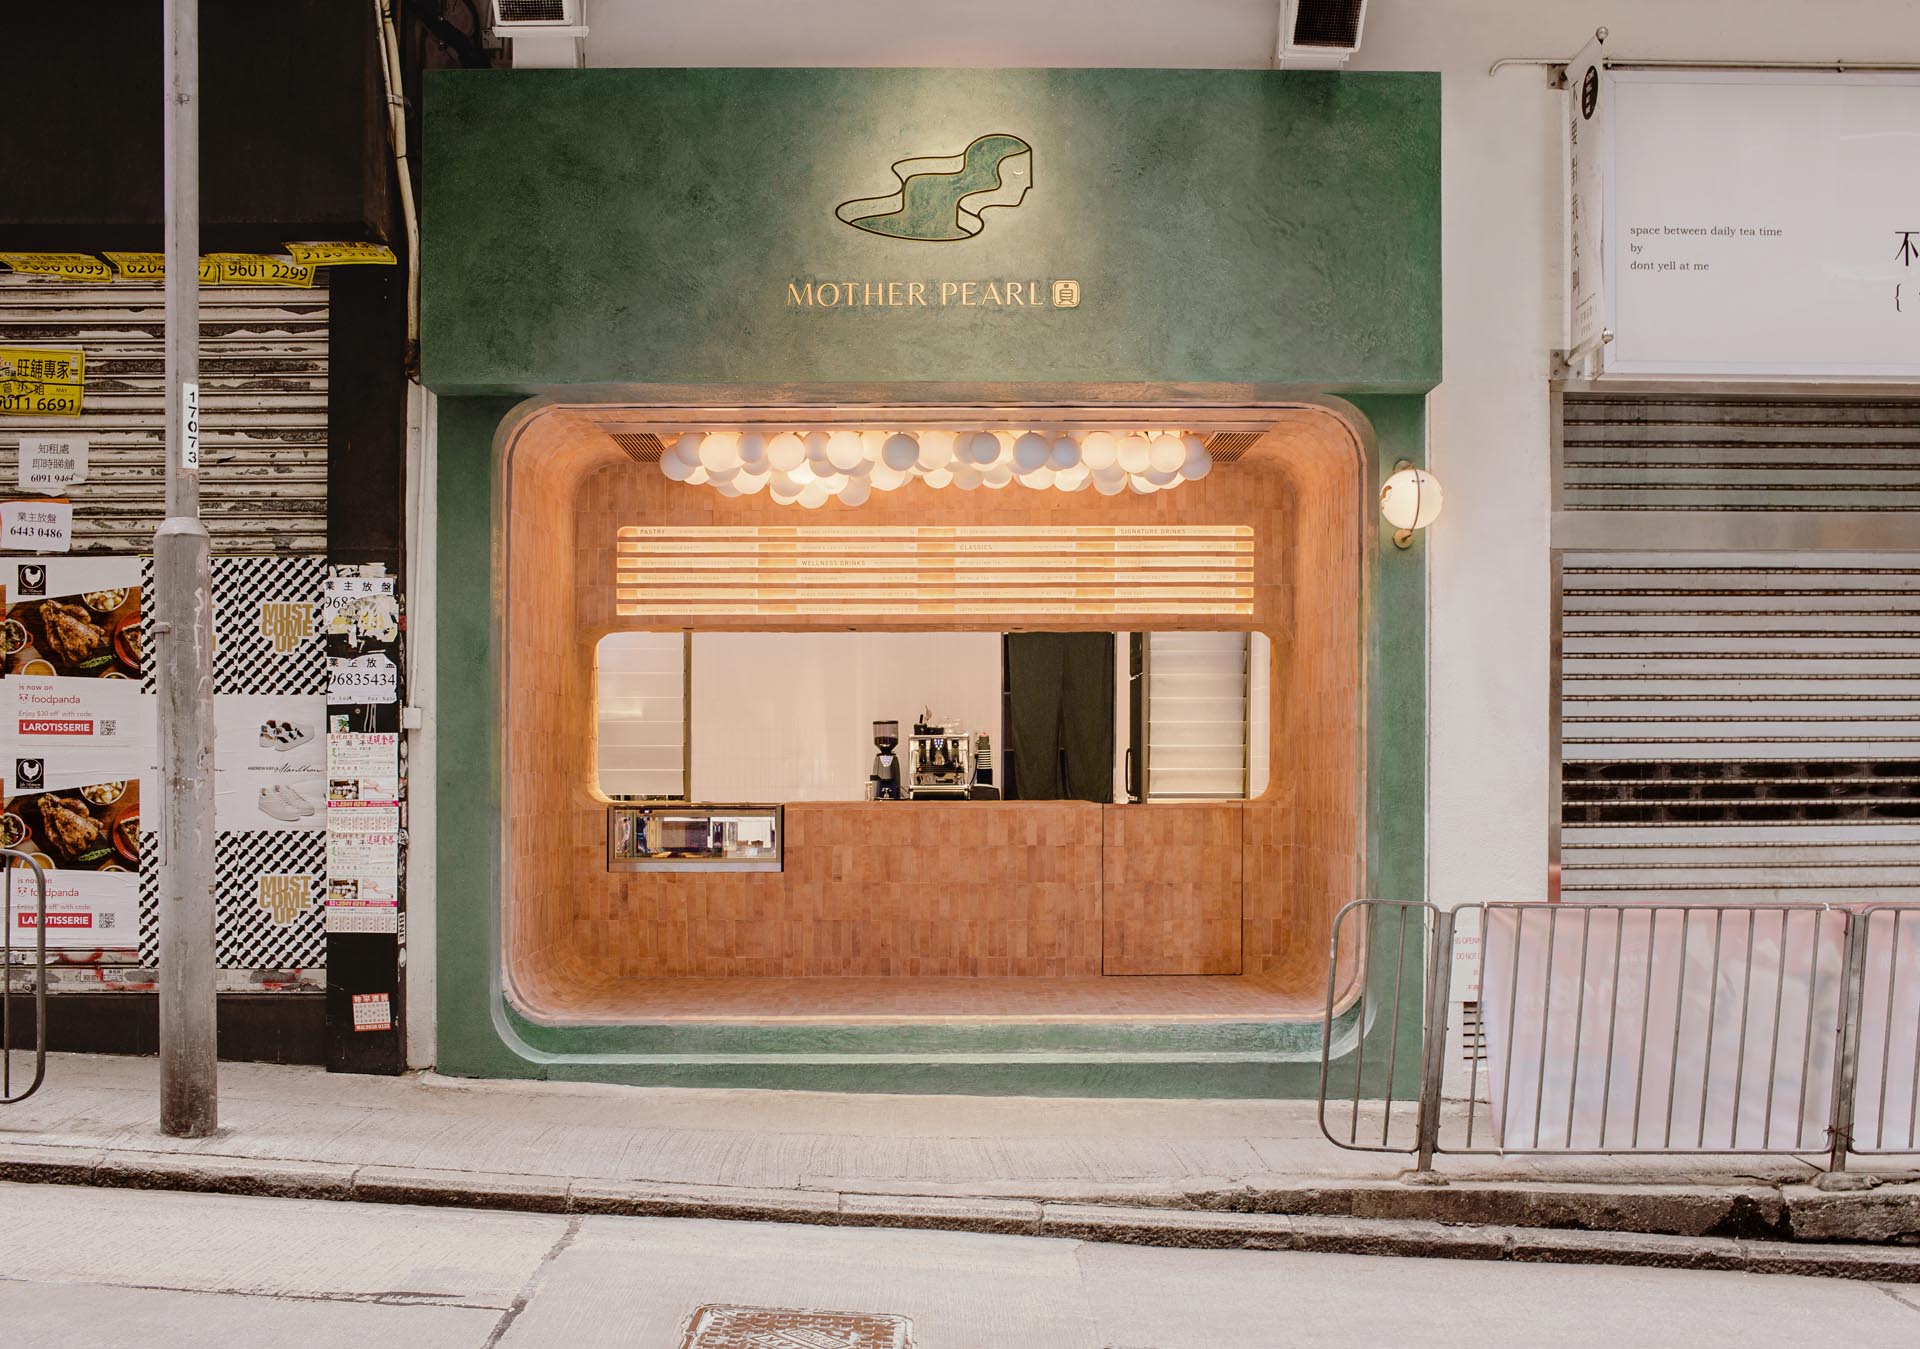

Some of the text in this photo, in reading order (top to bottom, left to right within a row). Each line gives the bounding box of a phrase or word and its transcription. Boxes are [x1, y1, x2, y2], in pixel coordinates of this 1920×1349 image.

[1630, 226, 1783, 238] space between daily tea time
[1630, 243, 1643, 255] by
[1894, 231, 1920, 267] 不
[228, 264, 265, 278] 9601
[271, 264, 308, 281] 2299
[1630, 261, 1709, 273] dont yell at me
[787, 282, 1044, 307] MOTHER PEARL
[37, 398, 74, 411] 6691
[188, 392, 197, 464] 17073
[31, 474, 51, 483] 6091
[18, 512, 57, 524] 業主放盤
[10, 526, 63, 539] 6443 0486
[325, 580, 392, 593] 業主放盤
[262, 603, 313, 621] MUST
[261, 619, 313, 637] COME
[275, 635, 299, 653] UP
[31, 694, 81, 705] foodpanda
[22, 722, 90, 732] LAROTISSERIE
[260, 876, 311, 894] MUST
[30, 888, 80, 899] fodpanda
[260, 892, 311, 909] COME
[273, 907, 297, 924] UP
